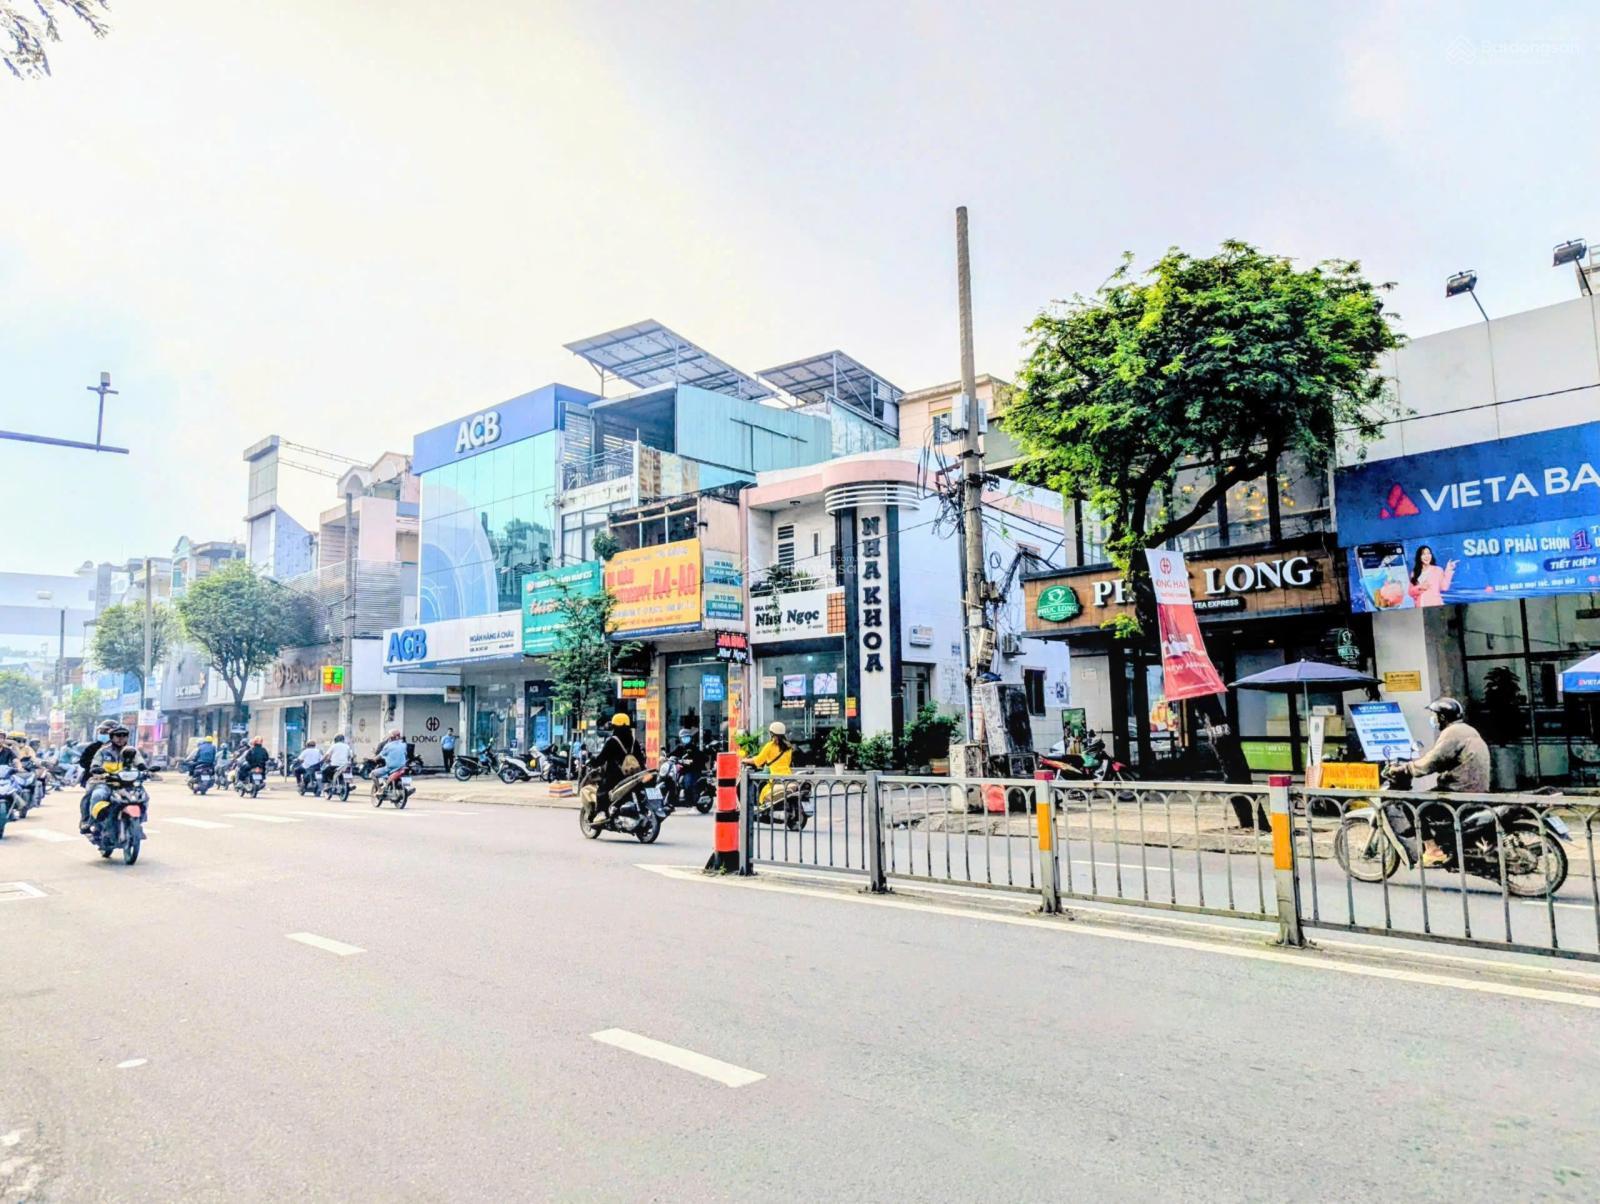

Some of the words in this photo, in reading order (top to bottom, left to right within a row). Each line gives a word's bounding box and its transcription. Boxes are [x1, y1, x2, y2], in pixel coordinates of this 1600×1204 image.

[455, 411, 501, 453] ACB
[1463, 538, 1500, 556] SAO
[1504, 534, 1538, 553] PHẢI
[1541, 536, 1570, 553] CHỌN
[1204, 557, 1314, 595] LONG
[755, 611, 783, 626] Như
[787, 609, 820, 625] Ngọc
[1208, 598, 1239, 608] EXPRESS
[386, 628, 428, 664] ACB
